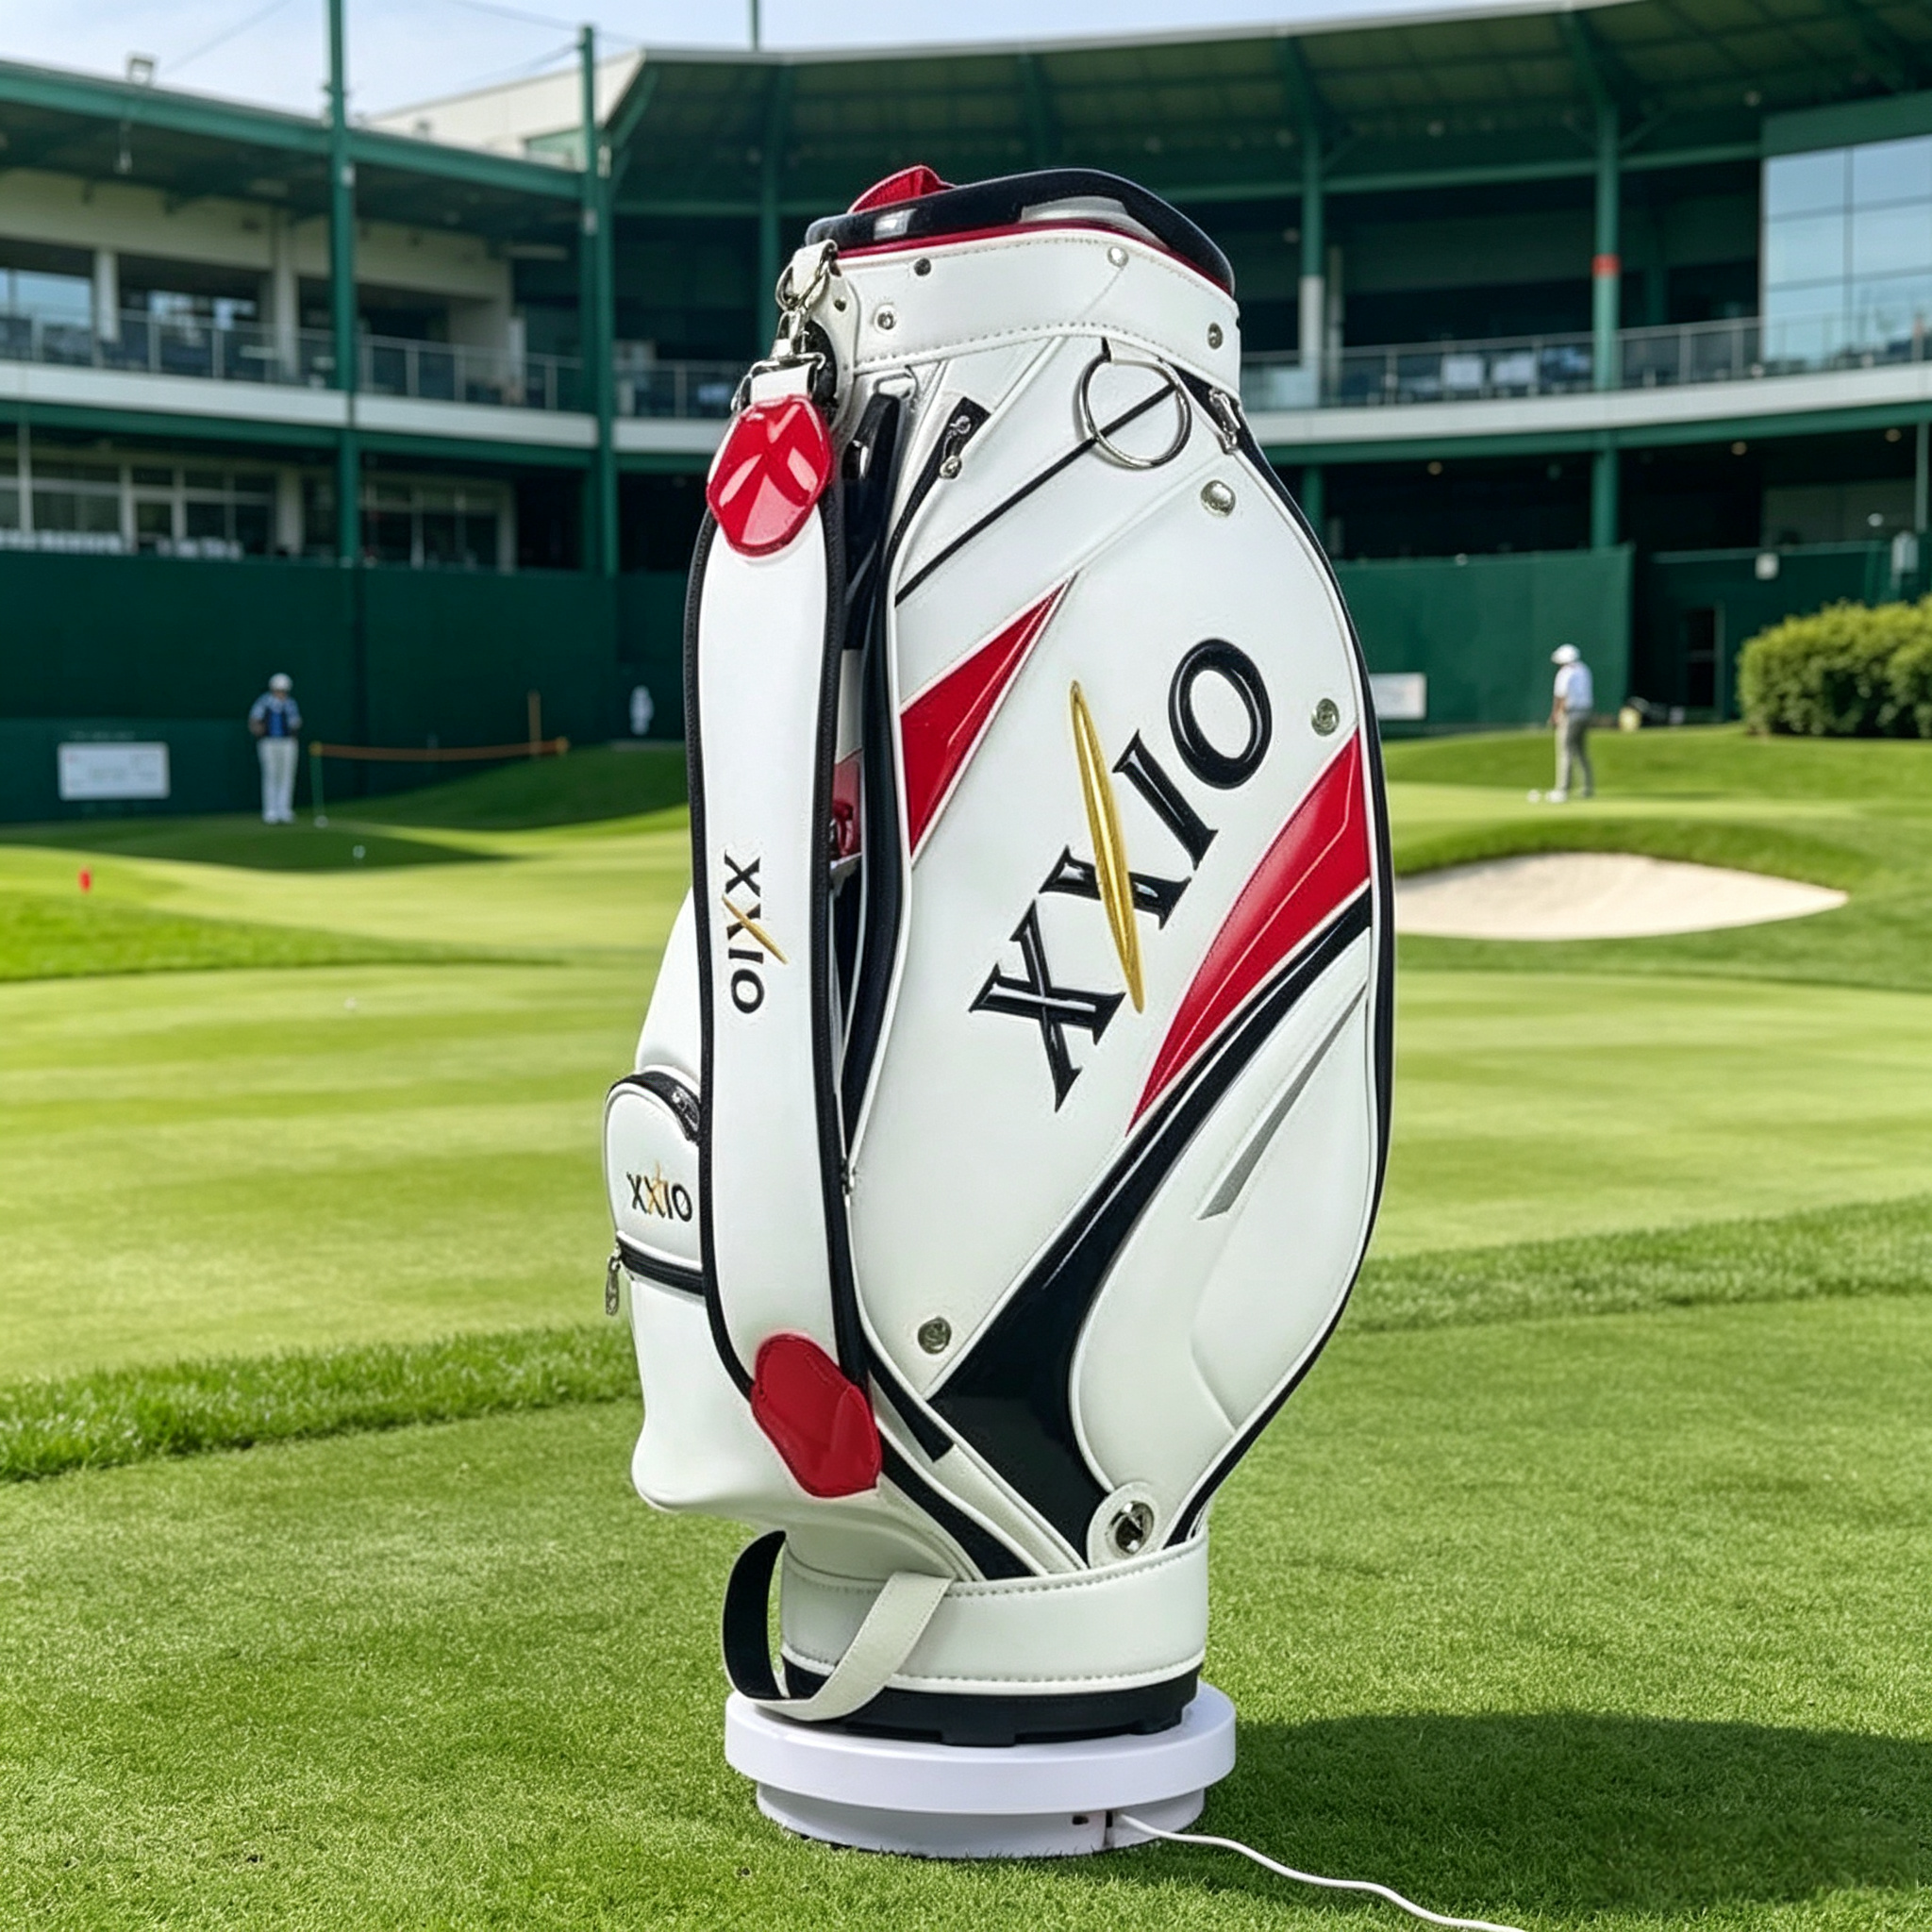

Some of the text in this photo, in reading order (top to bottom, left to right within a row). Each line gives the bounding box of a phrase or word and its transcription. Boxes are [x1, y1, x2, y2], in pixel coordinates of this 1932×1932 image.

[722, 849, 788, 1014] XXIO
[969, 638, 1273, 1113] XXIO
[625, 1161, 693, 1223] XXIO
